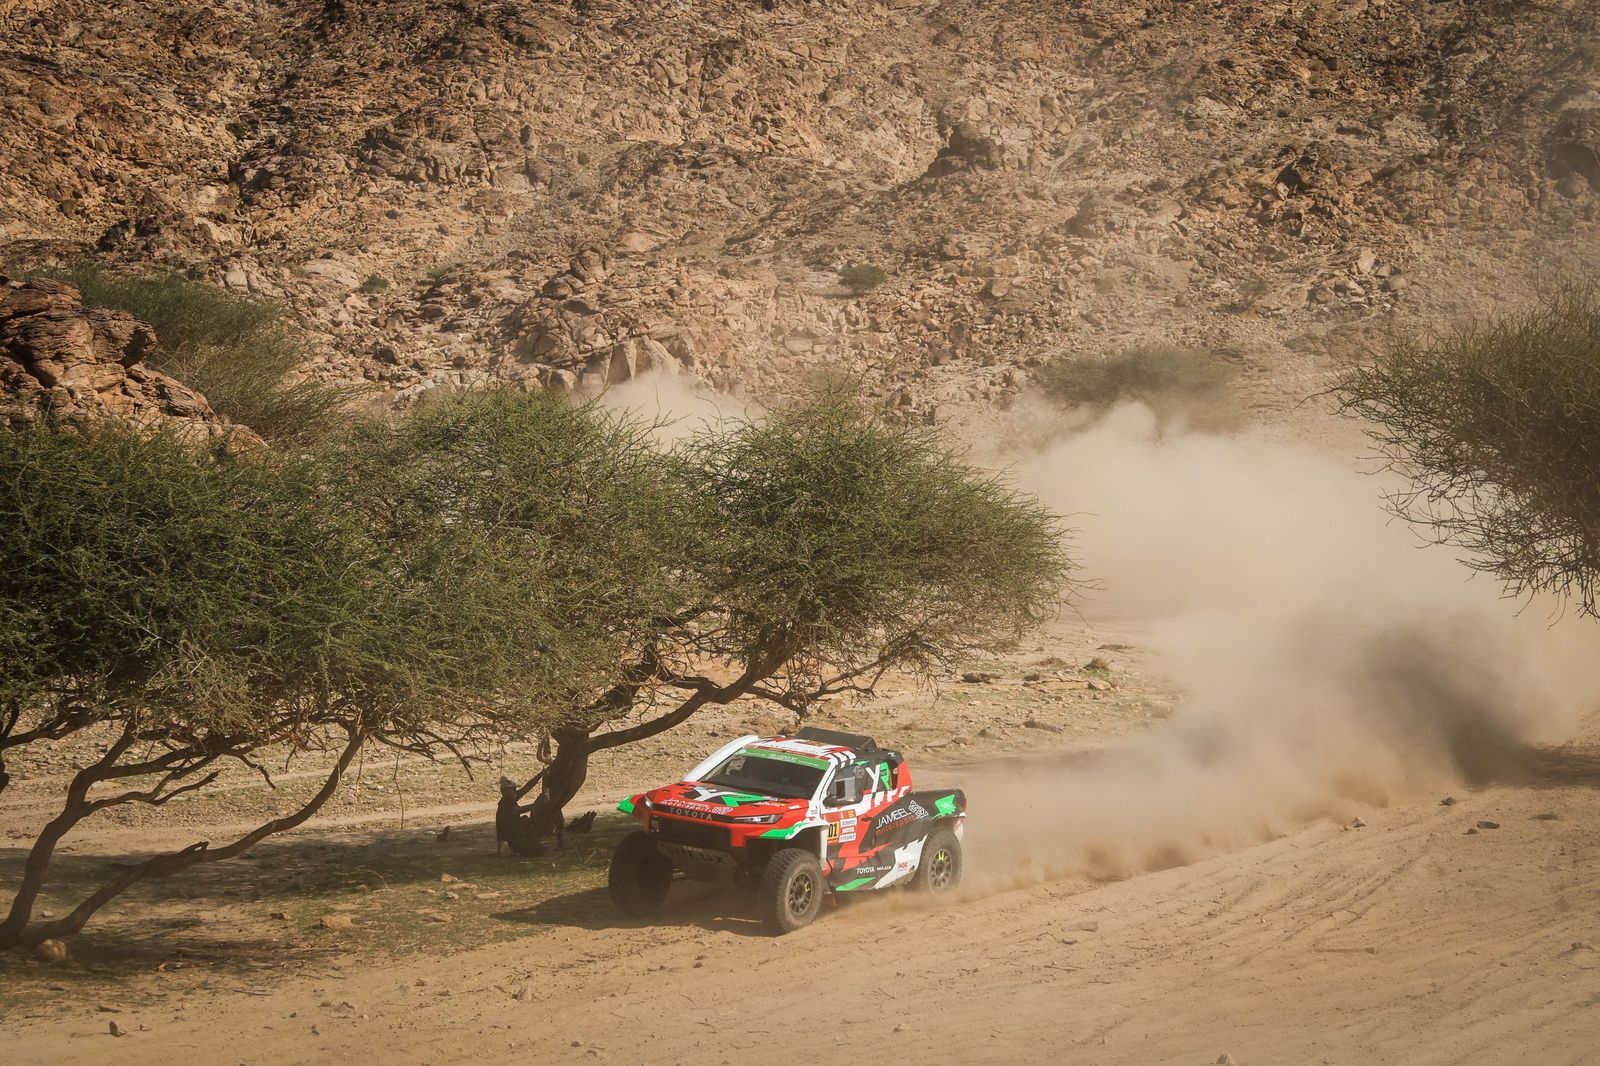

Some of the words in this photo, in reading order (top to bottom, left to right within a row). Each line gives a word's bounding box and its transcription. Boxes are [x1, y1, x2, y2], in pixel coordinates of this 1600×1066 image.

[669, 807, 713, 820] TOYOTA
[875, 808, 912, 830] JAMEEL
[856, 866, 875, 875] TOYOTA
